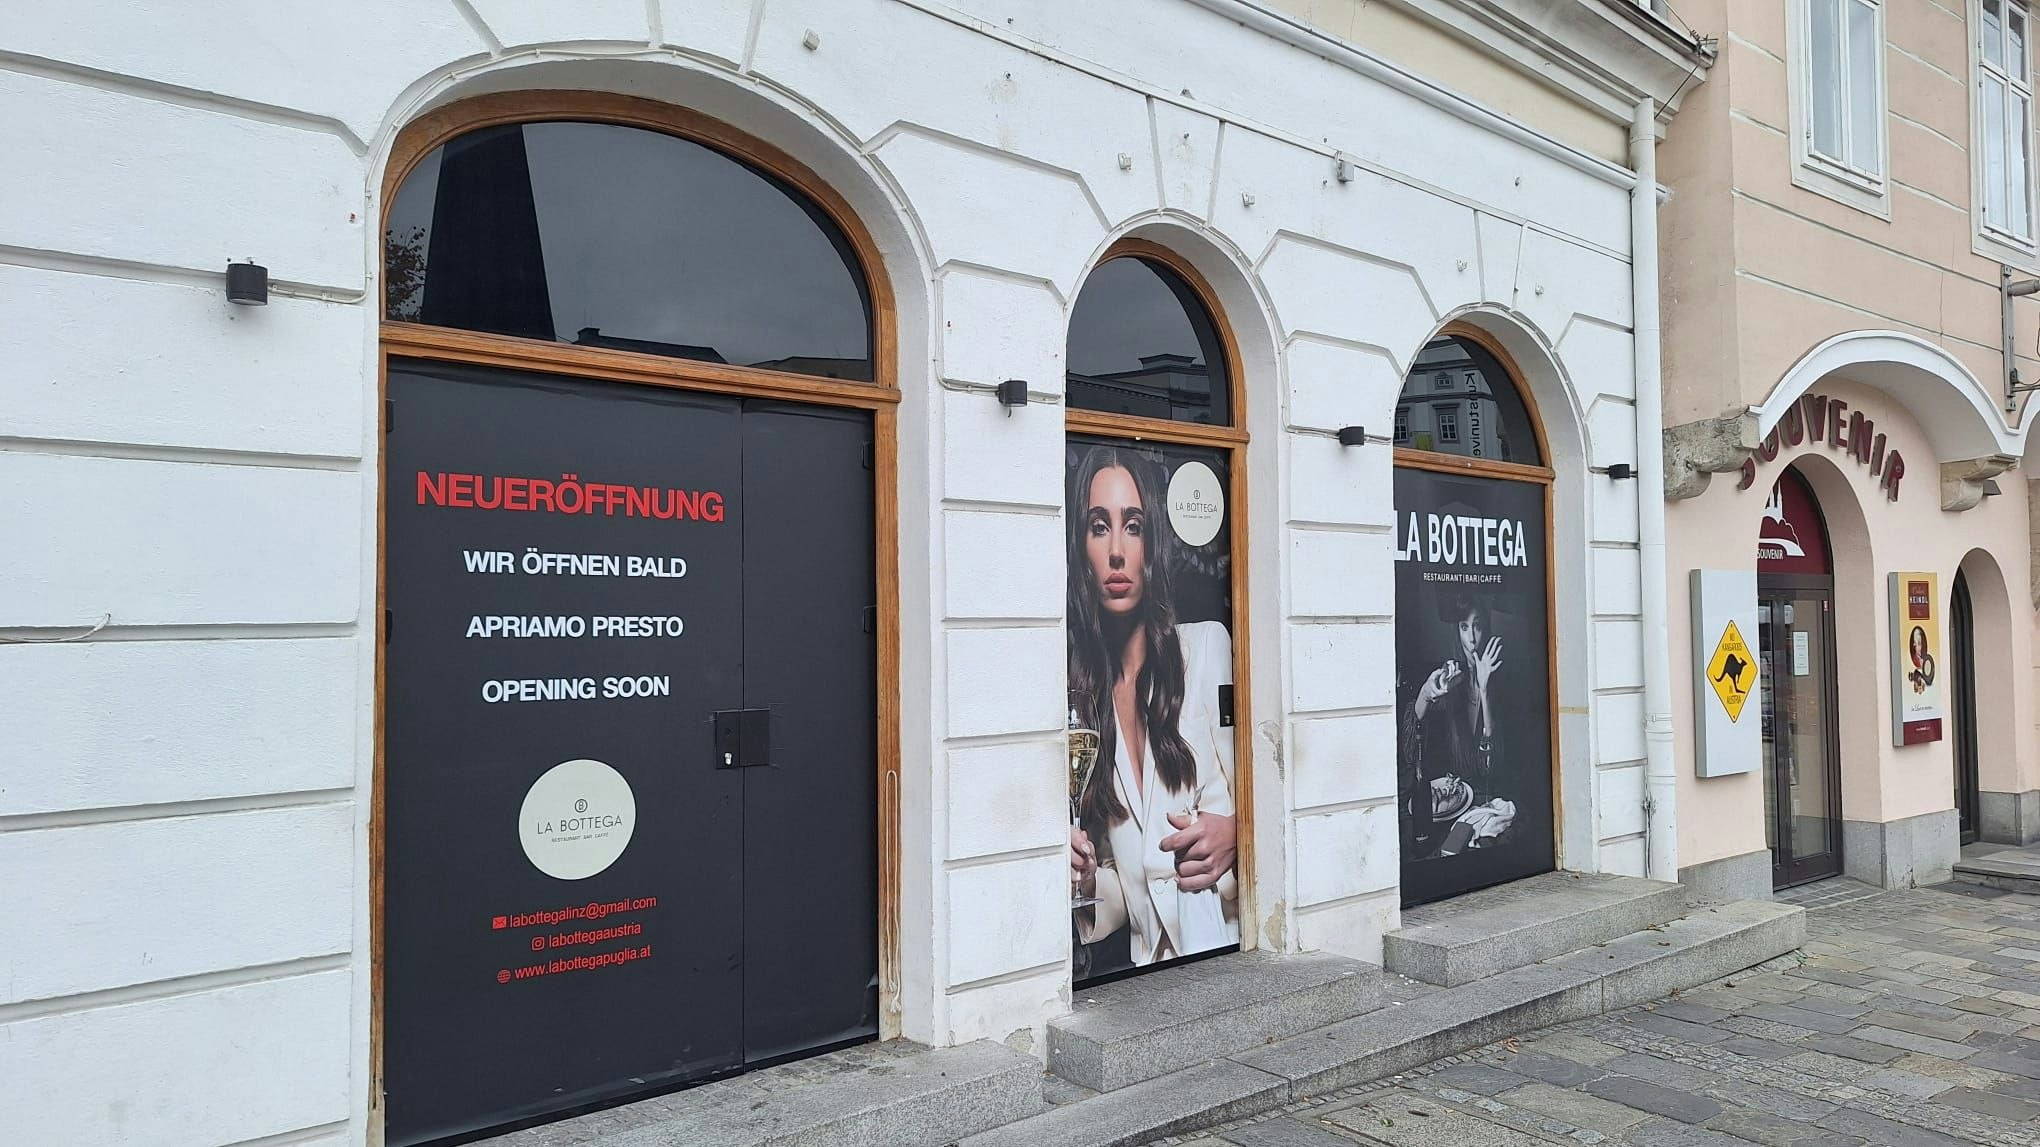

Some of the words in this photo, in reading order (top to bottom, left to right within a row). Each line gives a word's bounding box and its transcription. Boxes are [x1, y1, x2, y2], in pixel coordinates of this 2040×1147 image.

[416, 471, 725, 522] NEUERÖFFNUNG
[1176, 502, 1184, 511] LA
[1186, 502, 1218, 513] BOTTEGA
[1394, 510, 1422, 562] LA
[1428, 514, 1528, 567] BOTTEGA
[463, 550, 515, 574] WIR
[522, 547, 620, 577] ÖFFNEN
[626, 556, 687, 578] BALD
[465, 615, 586, 638] APRIAMO
[592, 616, 684, 638] PRESTO
[482, 678, 596, 702] OPENING
[602, 675, 670, 699] SOON
[537, 821, 553, 835] LA
[560, 815, 623, 832] BOTTEGA
[509, 896, 657, 929] labottegalinz@gmail.com
[548, 921, 642, 948] labottegaaustria
[514, 944, 652, 980] www.labottegapuglia.at
